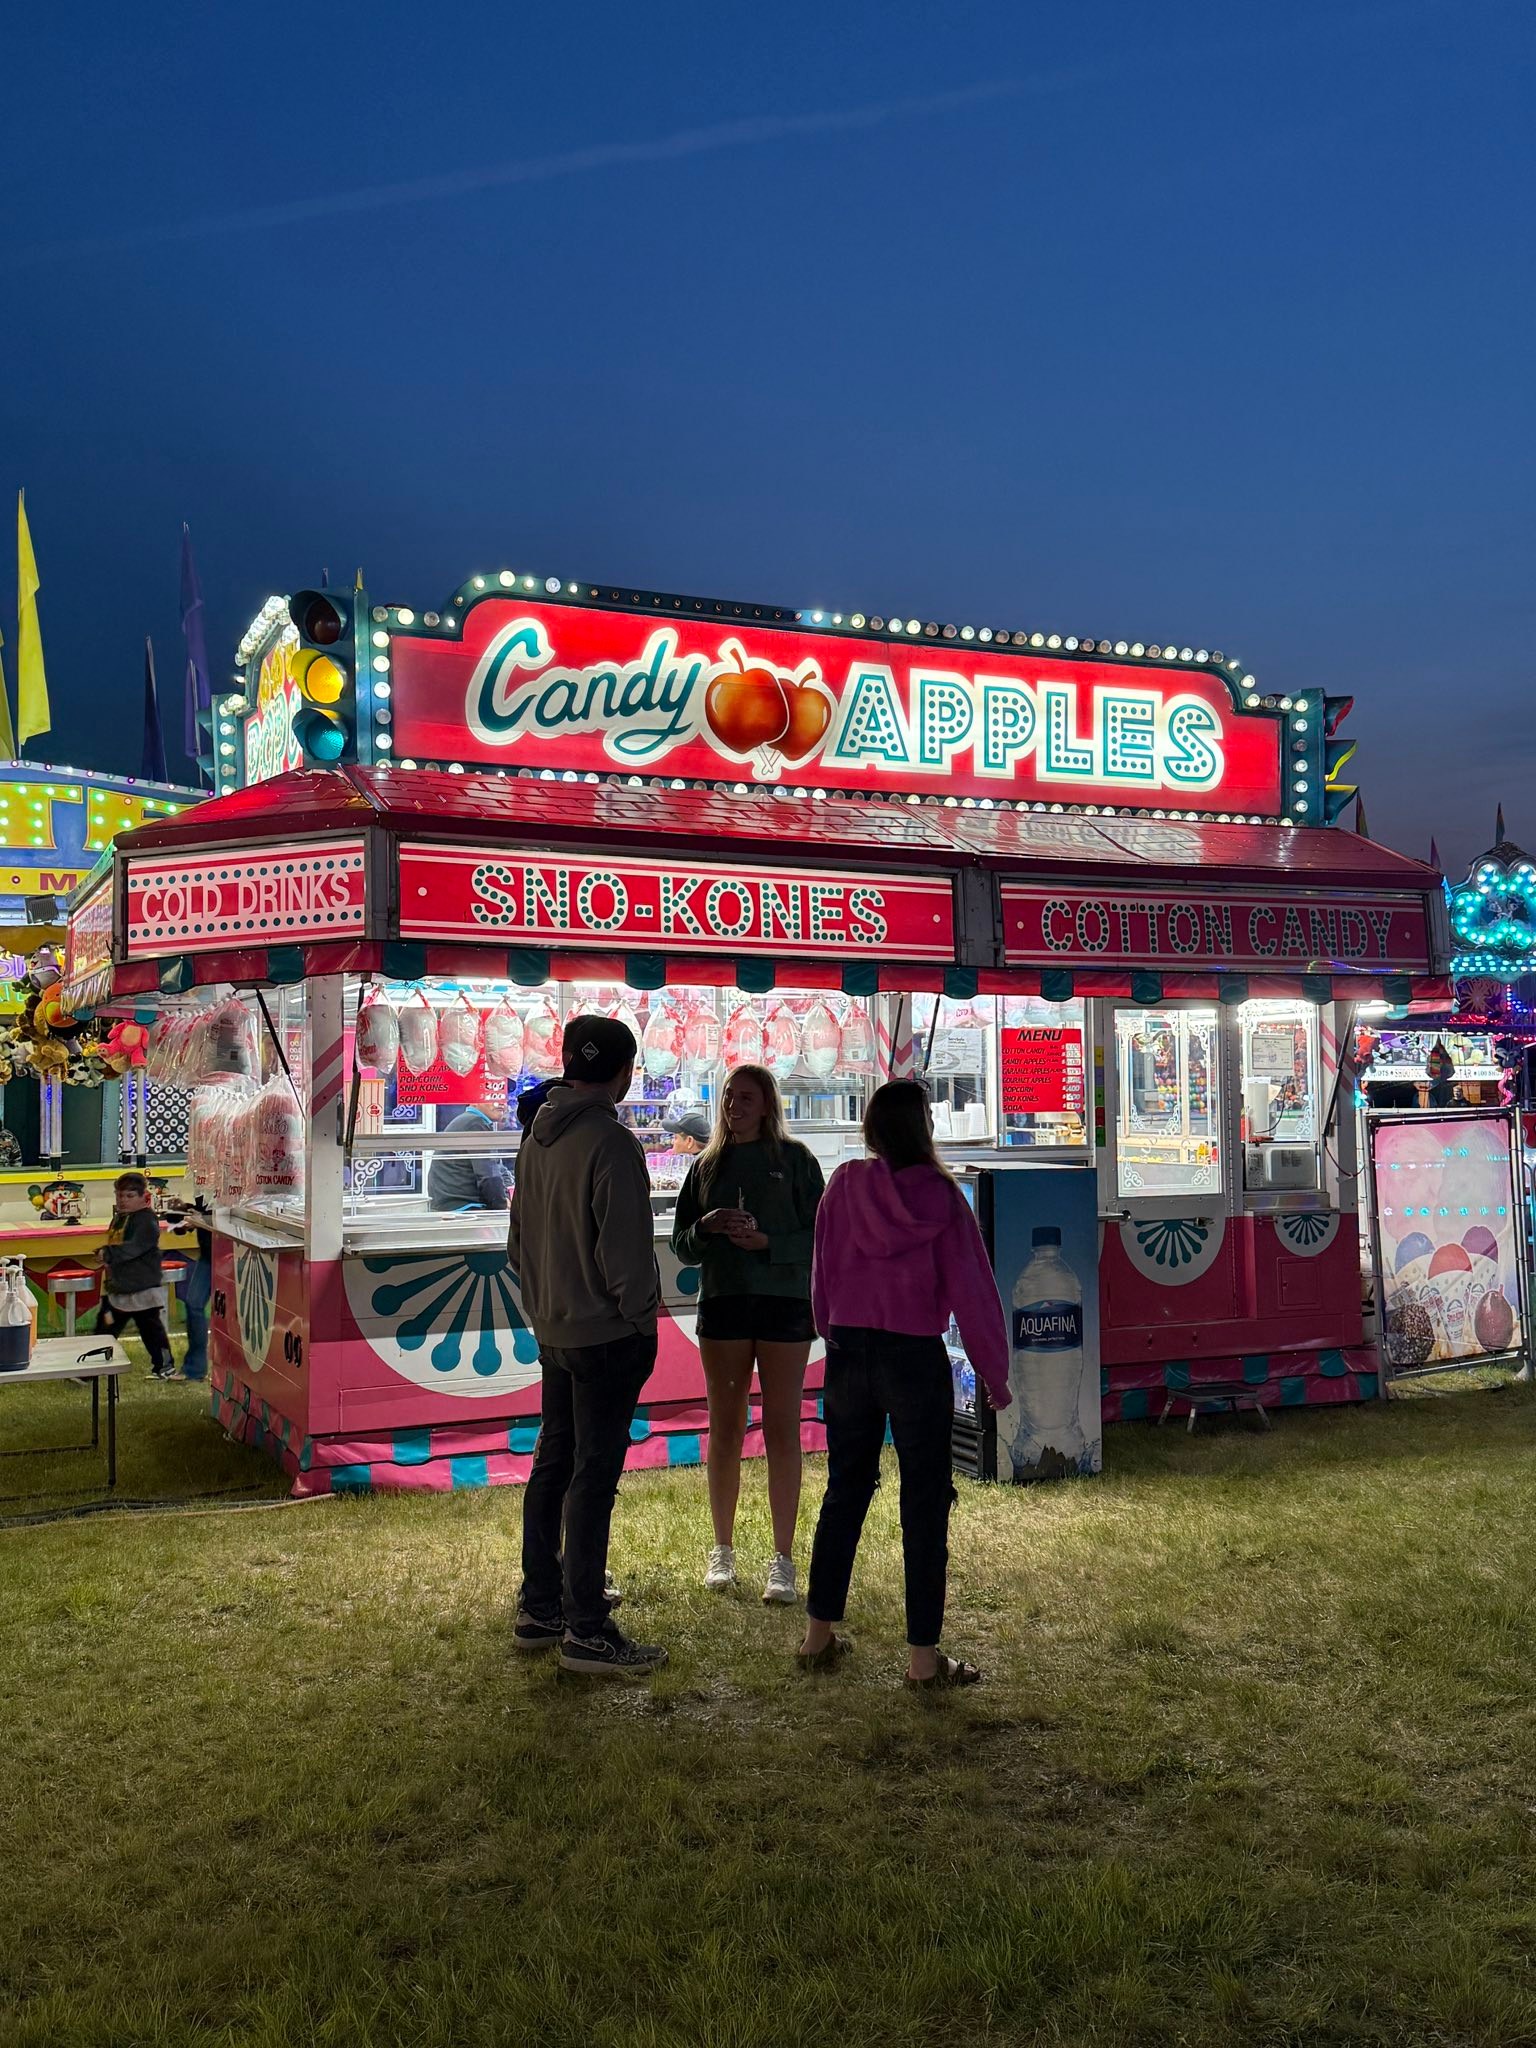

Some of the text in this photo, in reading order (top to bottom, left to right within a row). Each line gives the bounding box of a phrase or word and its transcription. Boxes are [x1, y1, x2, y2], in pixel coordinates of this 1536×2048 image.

[477, 627, 1216, 782] Candy APPLES
[141, 871, 351, 923] COLD DRINKS
[470, 864, 889, 944] SNO-KONES
[1040, 899, 1393, 960] COTTON CANDY
[1017, 1029, 1063, 1042] MENU
[399, 1075, 442, 1084] POPCORN
[419, 1084, 449, 1092] KONES
[399, 1095, 426, 1104] SODA
[56, 1173, 64, 1181] 5
[143, 1168, 151, 1177] 6
[273, 1174, 295, 1186] CANDY
[1019, 1314, 1077, 1338] AQUAFINA
